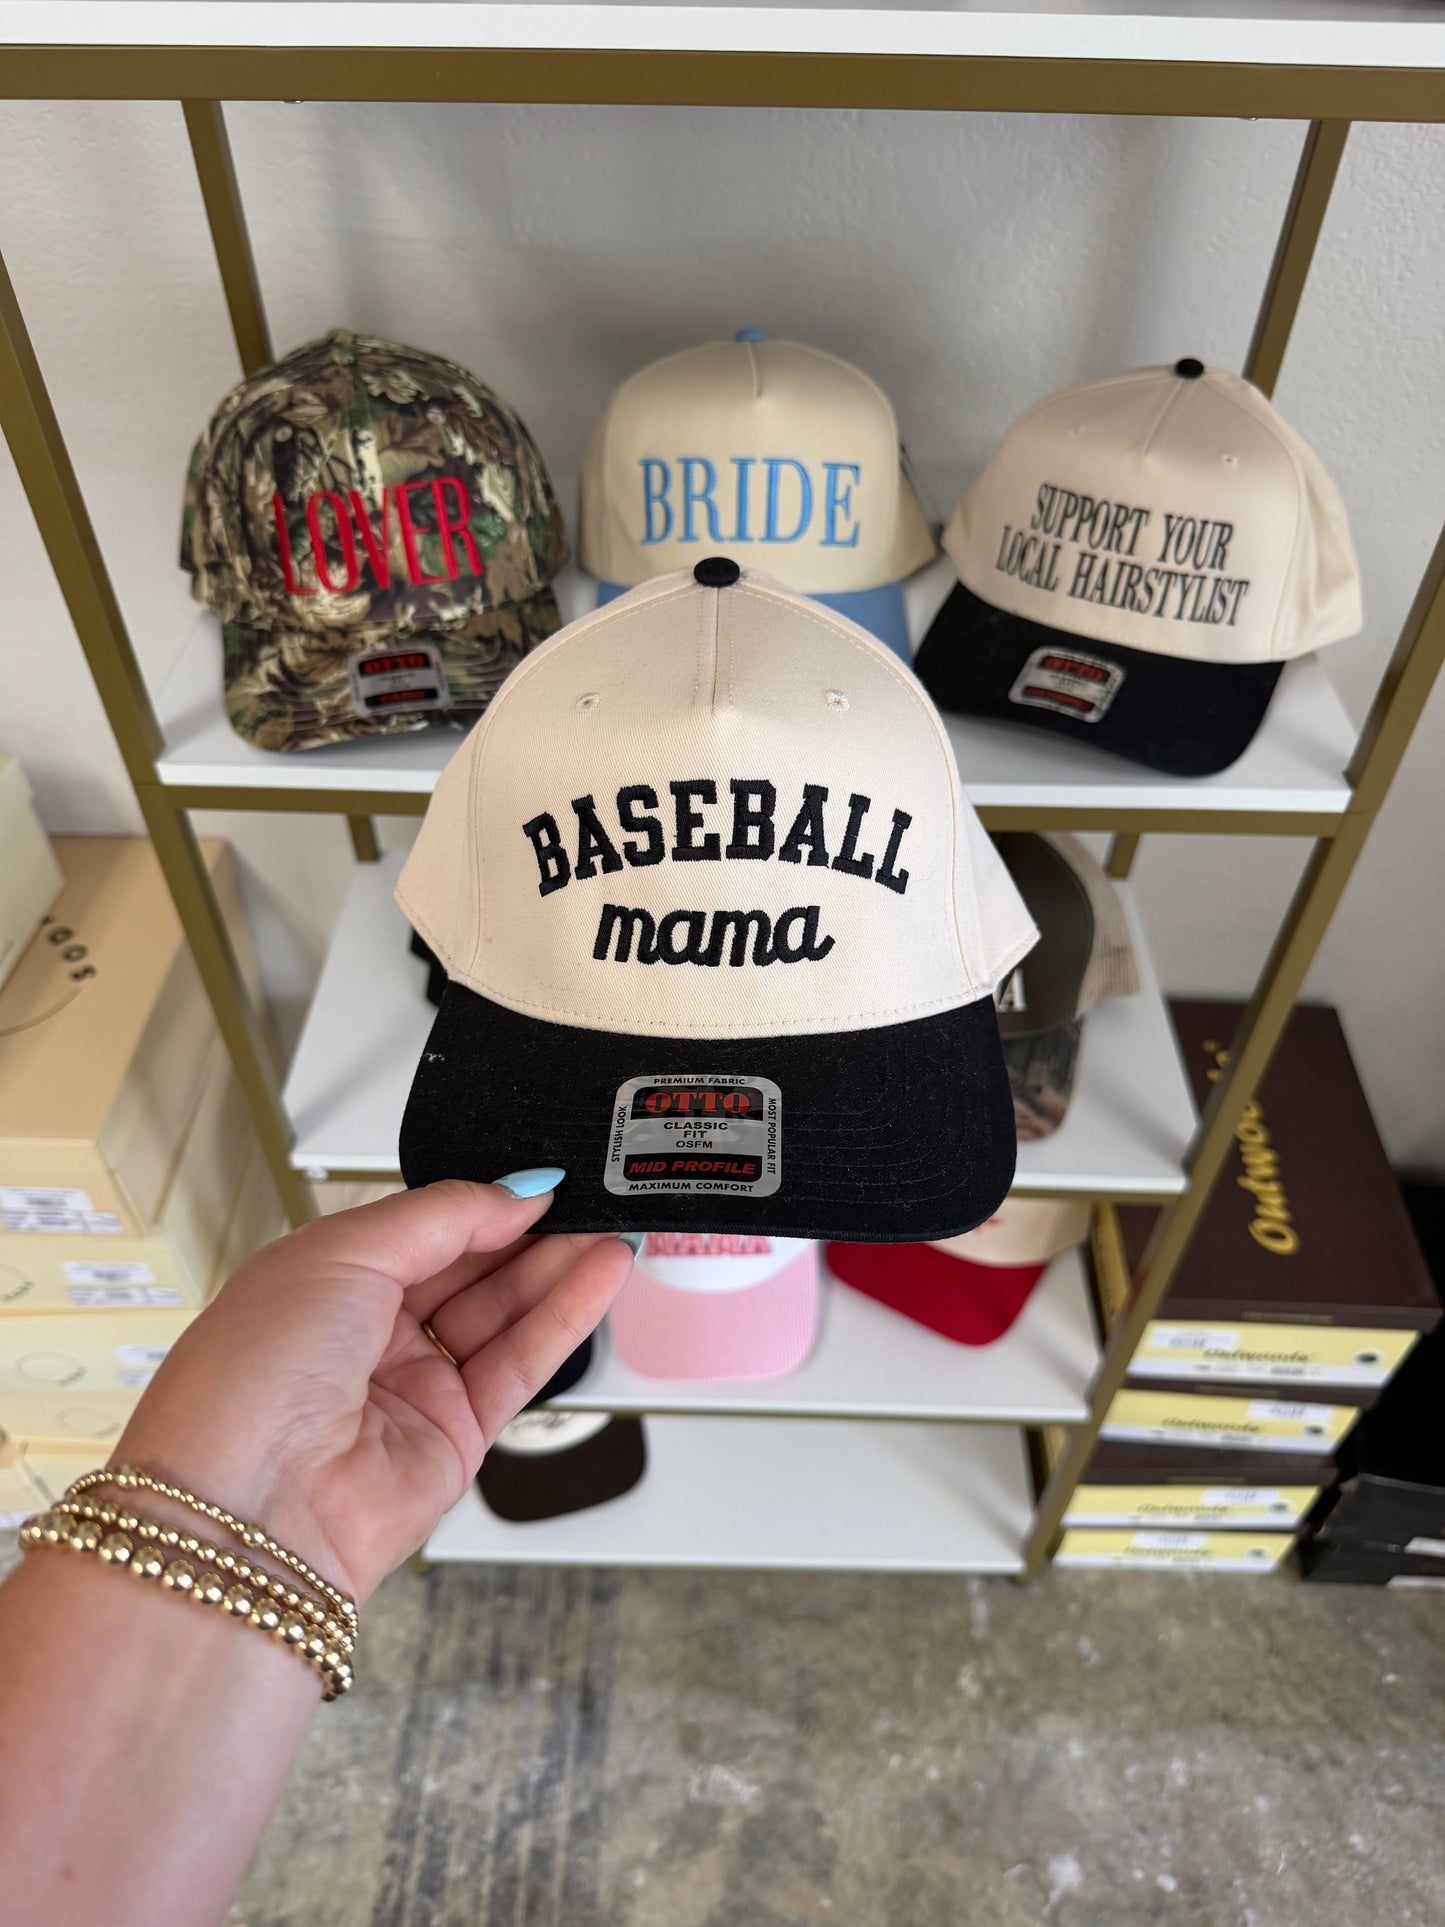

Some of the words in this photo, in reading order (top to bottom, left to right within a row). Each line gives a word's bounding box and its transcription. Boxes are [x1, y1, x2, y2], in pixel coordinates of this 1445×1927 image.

[638, 457, 862, 548] BRIDE
[272, 476, 484, 596] LOVER
[1030, 482, 1150, 557] SUPPORT
[1156, 514, 1233, 571] YOUR
[995, 526, 1062, 592] LOCAL
[1067, 550, 1249, 626] HAIRSTYLIST
[522, 778, 912, 897] BASEBALL
[593, 903, 836, 967] mama
[653, 1077, 705, 1085] PREMIUM
[708, 1077, 746, 1085] FABRIC
[645, 1092, 751, 1114] OTTO
[768, 1097, 777, 1121] MOST
[617, 1105, 628, 1128] LOOK
[663, 1121, 729, 1130] CLASSIC
[675, 1140, 713, 1149] OSFM
[683, 1130, 707, 1138] FIT
[767, 1122, 777, 1160] POPULAR
[611, 1130, 624, 1162] STYLISH
[629, 1161, 668, 1174] MID
[671, 1160, 757, 1175] PROFILE
[767, 1161, 776, 1175] FIT
[628, 1182, 692, 1192] MAXIMUM
[695, 1182, 754, 1192] COMFORT
